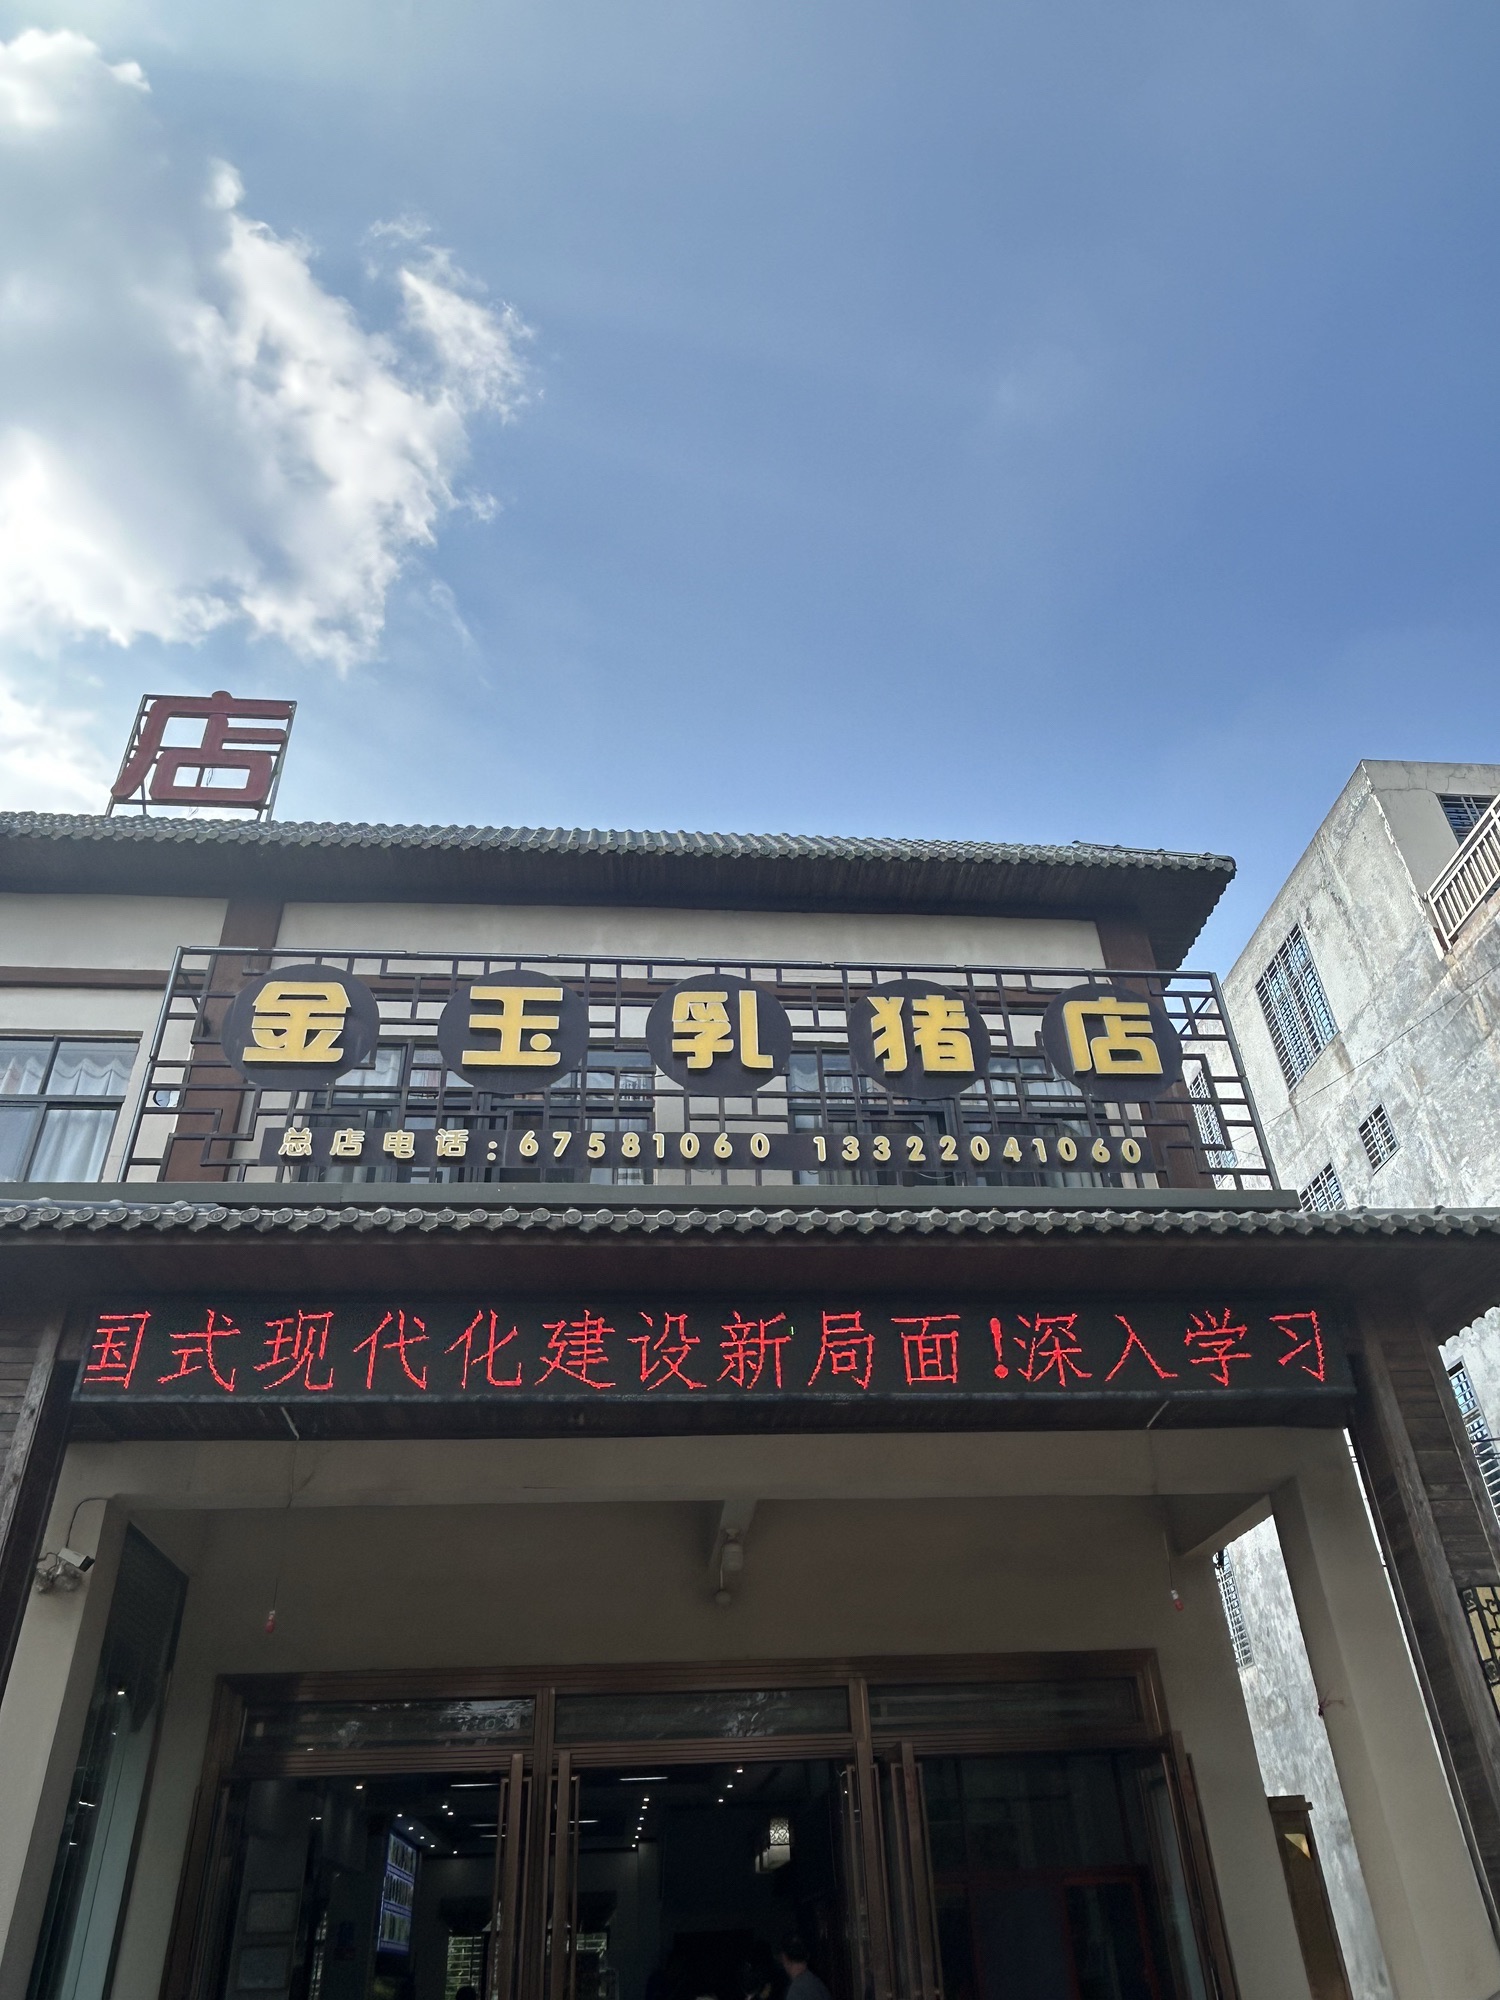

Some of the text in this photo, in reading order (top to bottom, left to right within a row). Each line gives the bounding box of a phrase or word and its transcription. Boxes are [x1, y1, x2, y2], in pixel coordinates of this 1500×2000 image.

[111, 690, 295, 809] 店
[242, 981, 1164, 1076] 金玉乳猪店
[812, 1135, 1143, 1165] 13322041060
